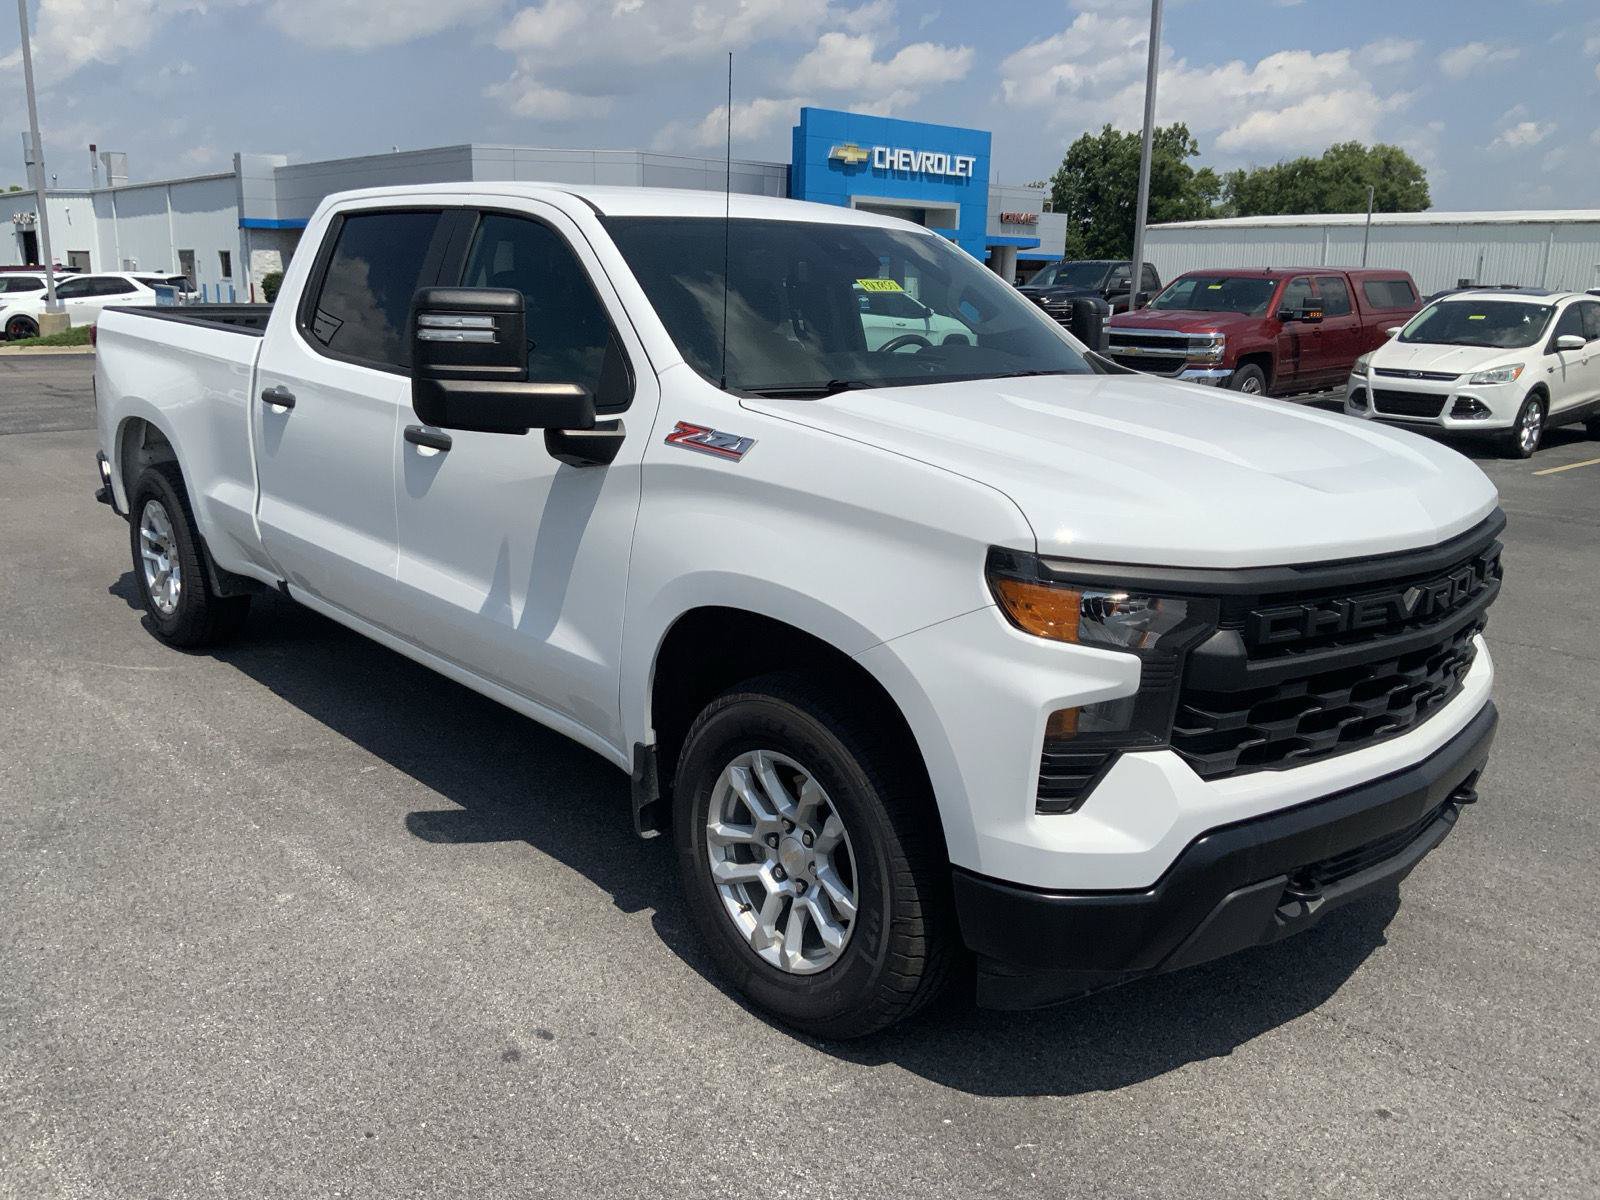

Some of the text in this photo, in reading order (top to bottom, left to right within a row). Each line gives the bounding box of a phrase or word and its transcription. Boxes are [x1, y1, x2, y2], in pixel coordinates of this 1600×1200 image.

[872, 146, 976, 178] CHEVROLET
[1001, 211, 1039, 225] GMC
[664, 420, 758, 463] Z71
[1248, 541, 1503, 645] CHEVROLE
